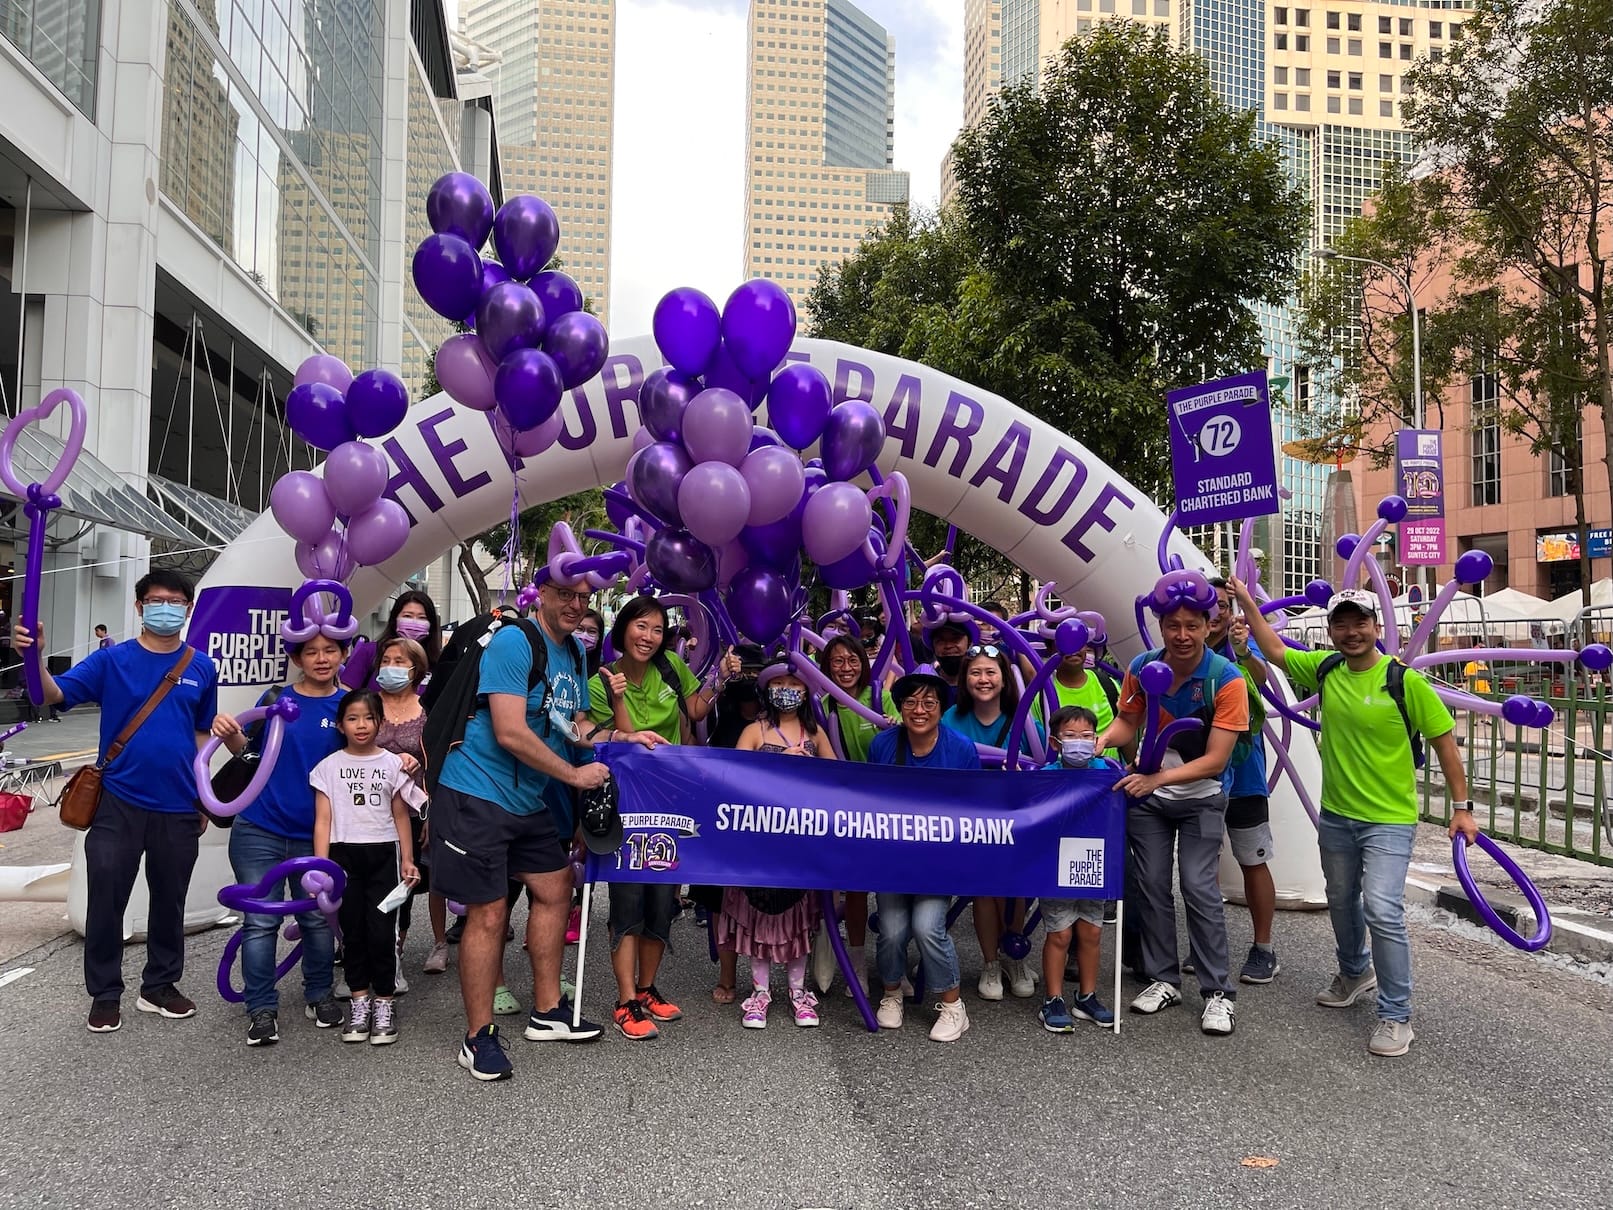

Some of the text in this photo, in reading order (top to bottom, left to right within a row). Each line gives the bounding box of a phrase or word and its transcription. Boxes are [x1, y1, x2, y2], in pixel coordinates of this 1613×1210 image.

[1178, 387, 1254, 413] THE PURPLE PARADE
[1206, 421, 1235, 451] 72
[337, 407, 492, 530] HE
[1197, 471, 1252, 494] STANDARD
[1180, 484, 1273, 513] CHARTERED BANK
[1590, 531, 1608, 539] FREE
[208, 632, 287, 658] PURPLE
[340, 768, 387, 780] LOVE ME
[346, 782, 382, 794] YES NO
[629, 816, 659, 826] PURPLE
[660, 816, 692, 829] PARADE
[715, 803, 1015, 845] STANDARD CHARTERED BANK
[1086, 849, 1103, 861] THE
[1069, 861, 1103, 874] PURPLE
[1069, 873, 1103, 886] PARADE
